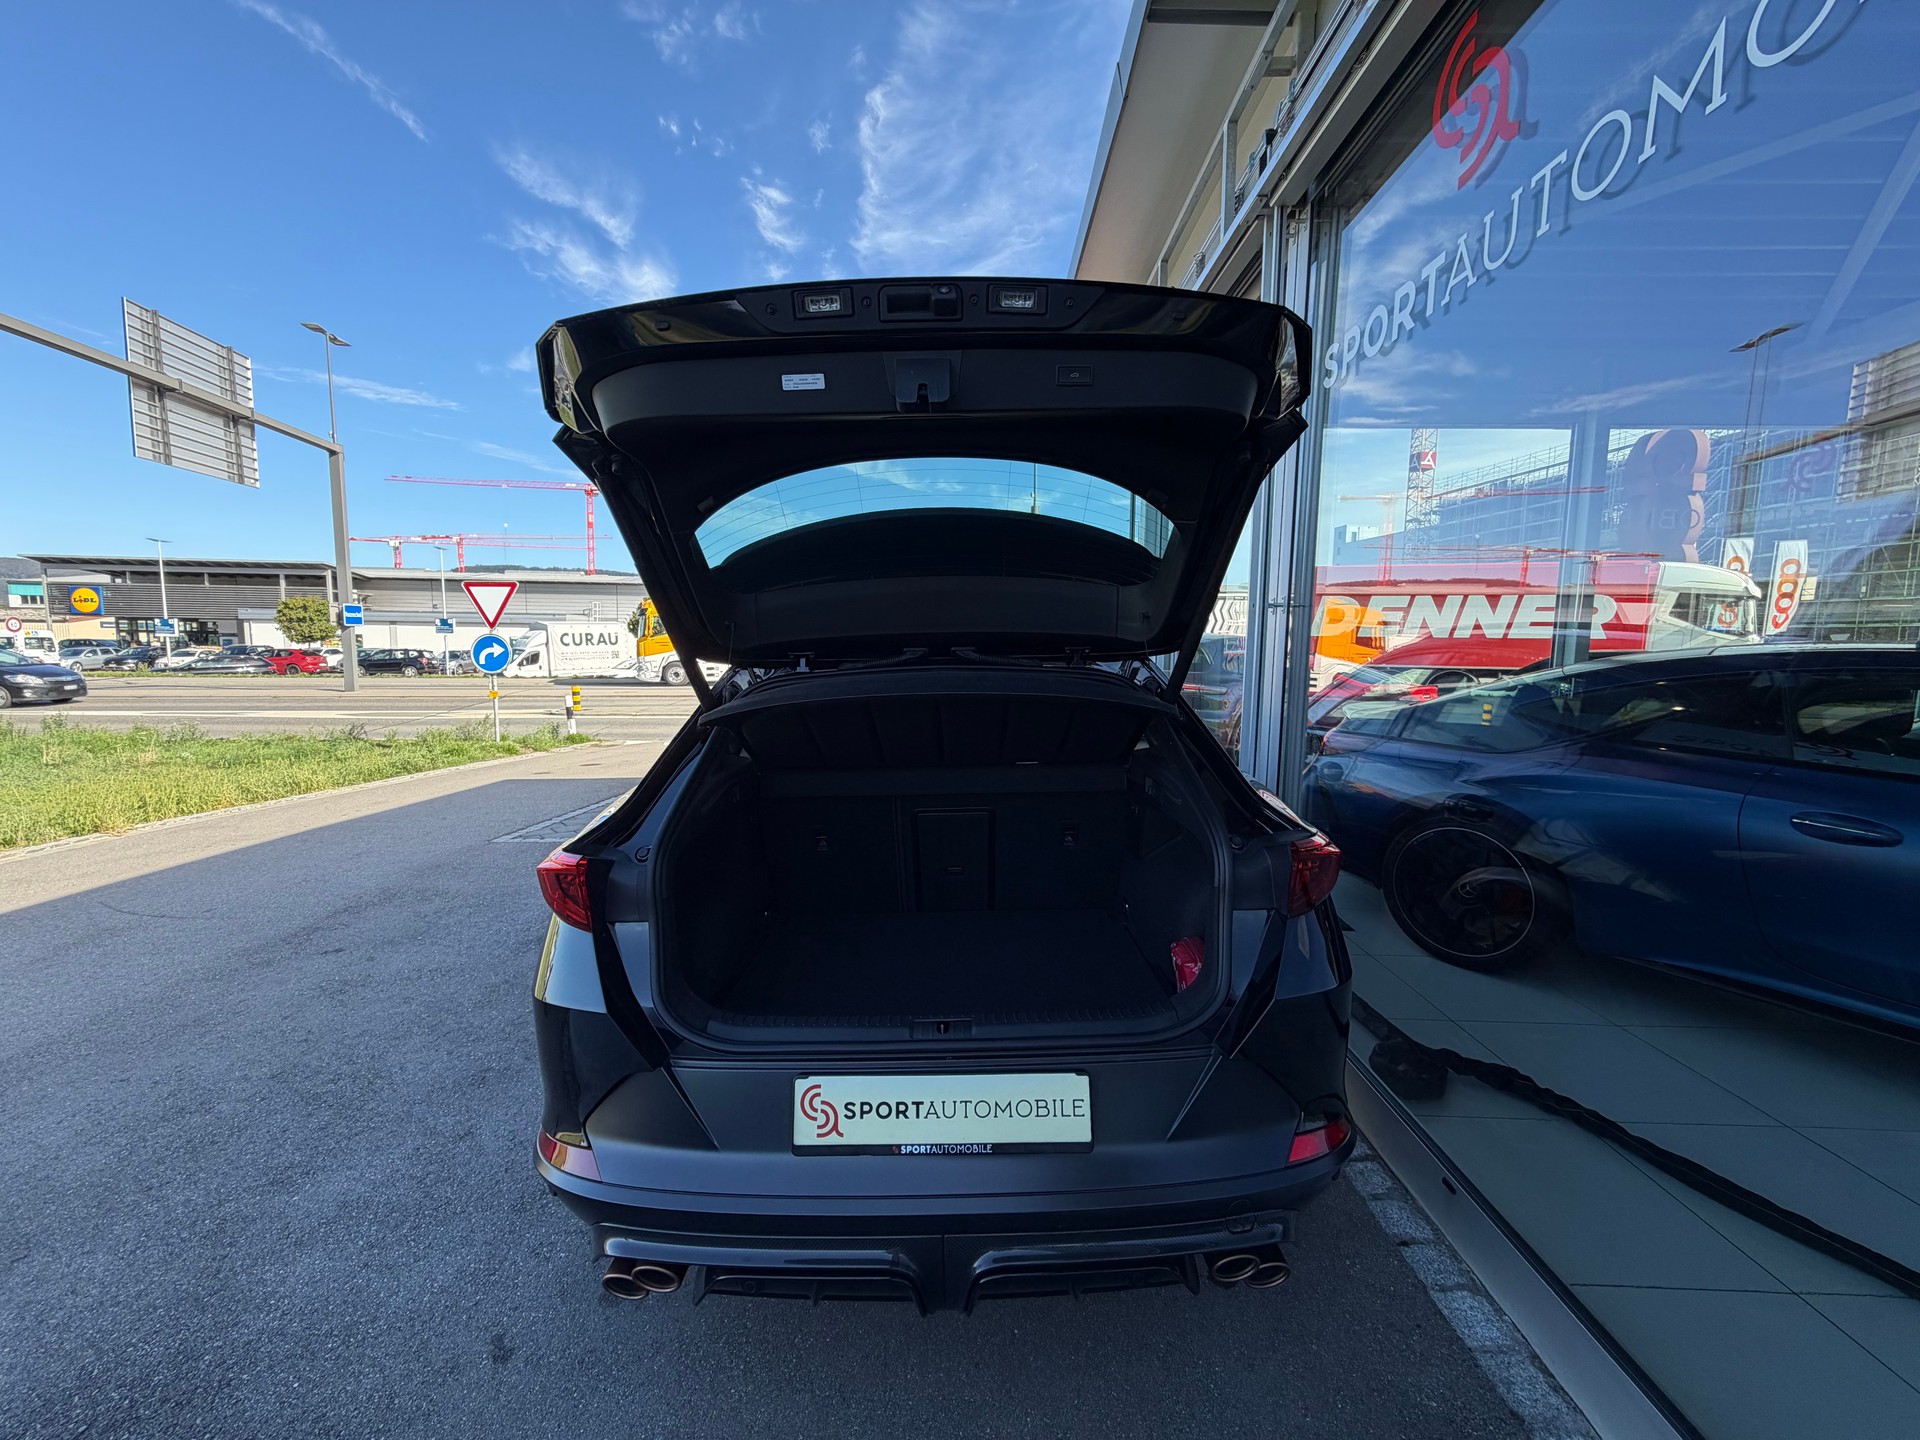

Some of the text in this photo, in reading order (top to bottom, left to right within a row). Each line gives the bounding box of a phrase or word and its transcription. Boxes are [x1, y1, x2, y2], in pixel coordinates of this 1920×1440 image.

[1323, 0, 1872, 389] SPORTAUTOMO
[1771, 558, 1806, 630] coop
[1311, 595, 1617, 639] DENNER
[843, 1099, 1085, 1120] SPORTAUTOMOBILE
[900, 1144, 993, 1154] SPORTAUTOMOBILE
